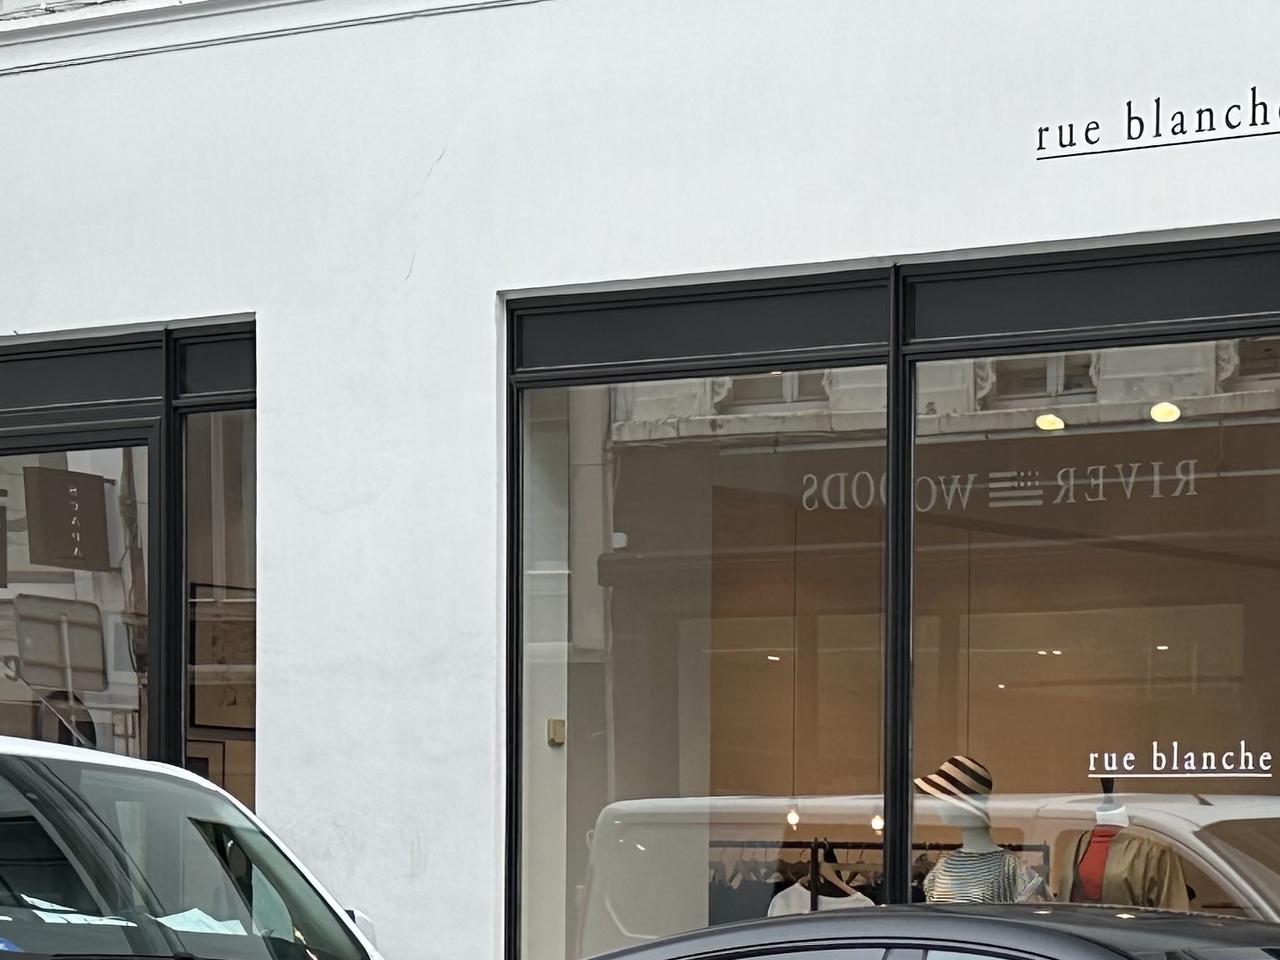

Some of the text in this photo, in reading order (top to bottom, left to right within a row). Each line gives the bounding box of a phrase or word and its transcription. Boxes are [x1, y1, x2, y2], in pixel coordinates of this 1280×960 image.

[1036, 119, 1101, 151] rue
[1088, 738, 1273, 772] rue blanche
